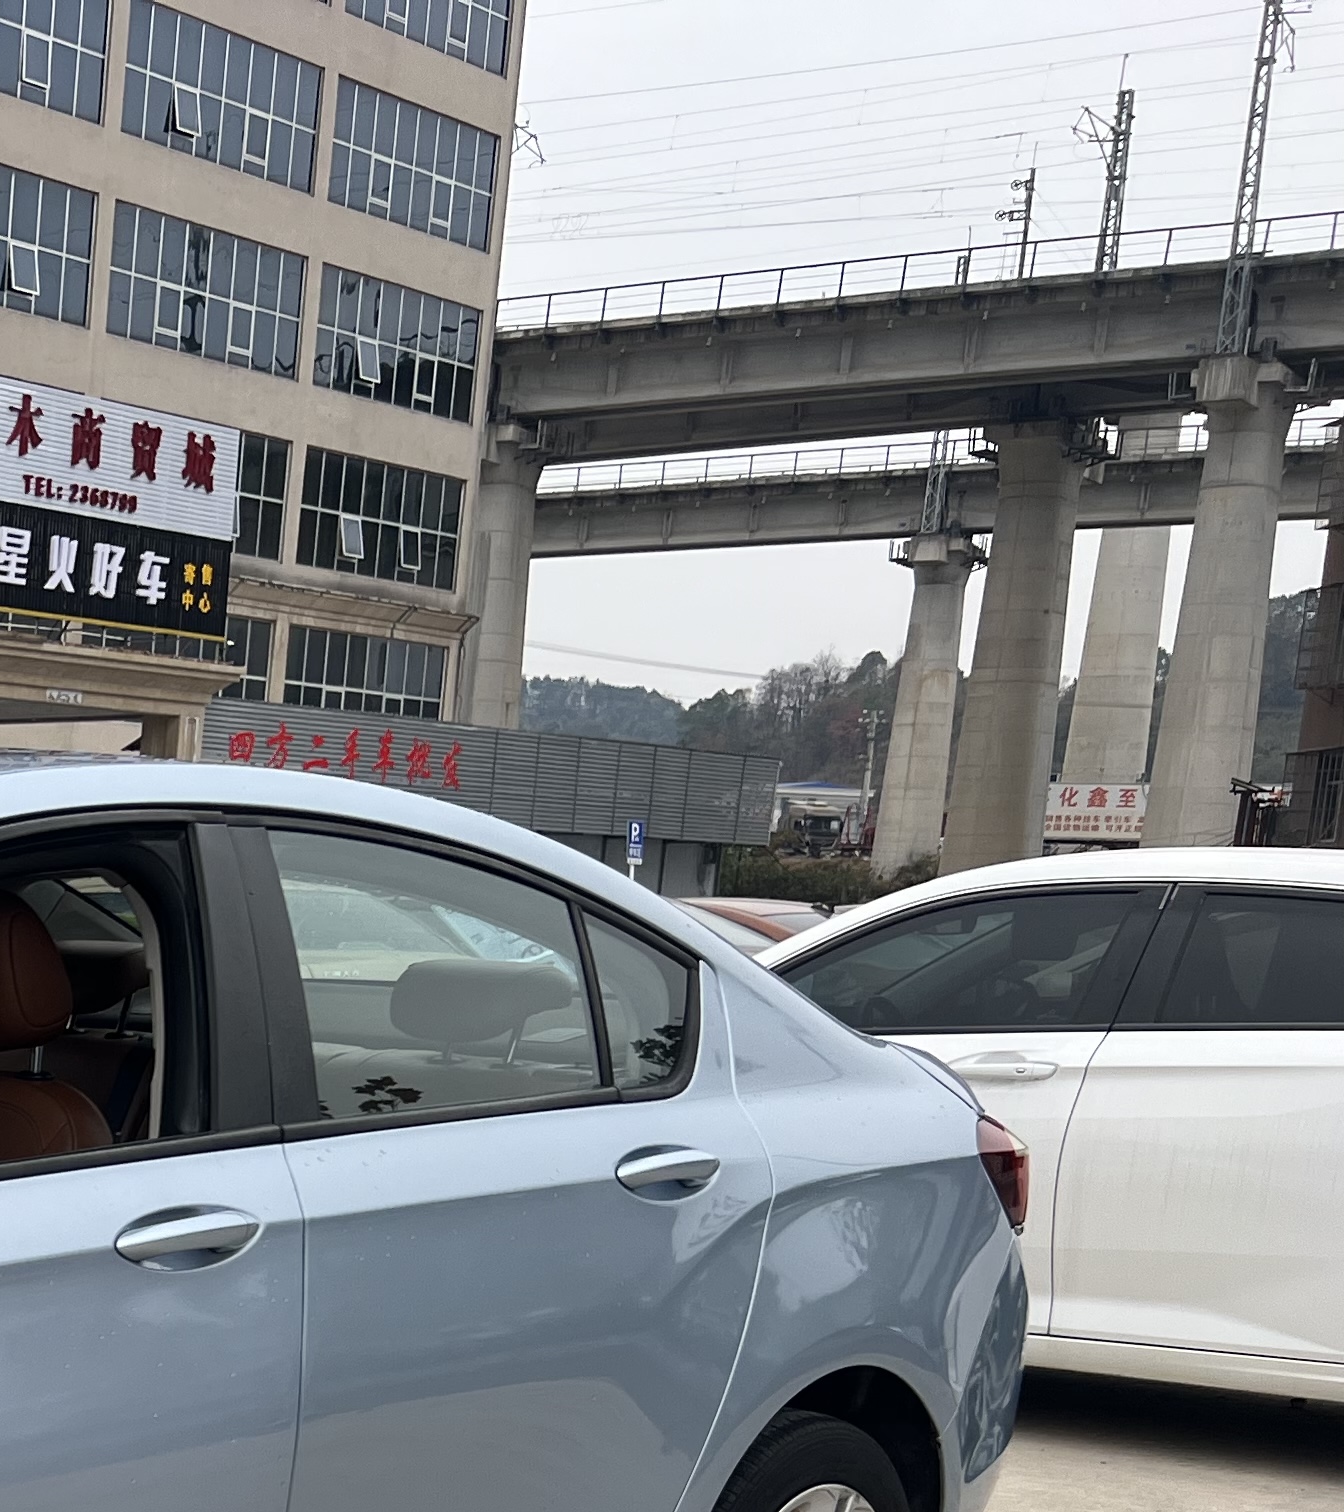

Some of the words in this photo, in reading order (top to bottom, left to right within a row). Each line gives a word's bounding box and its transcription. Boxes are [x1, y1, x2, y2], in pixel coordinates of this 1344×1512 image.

[22, 474, 63, 500] TEL:
[1047, 786, 1138, 809] 化鑫至
